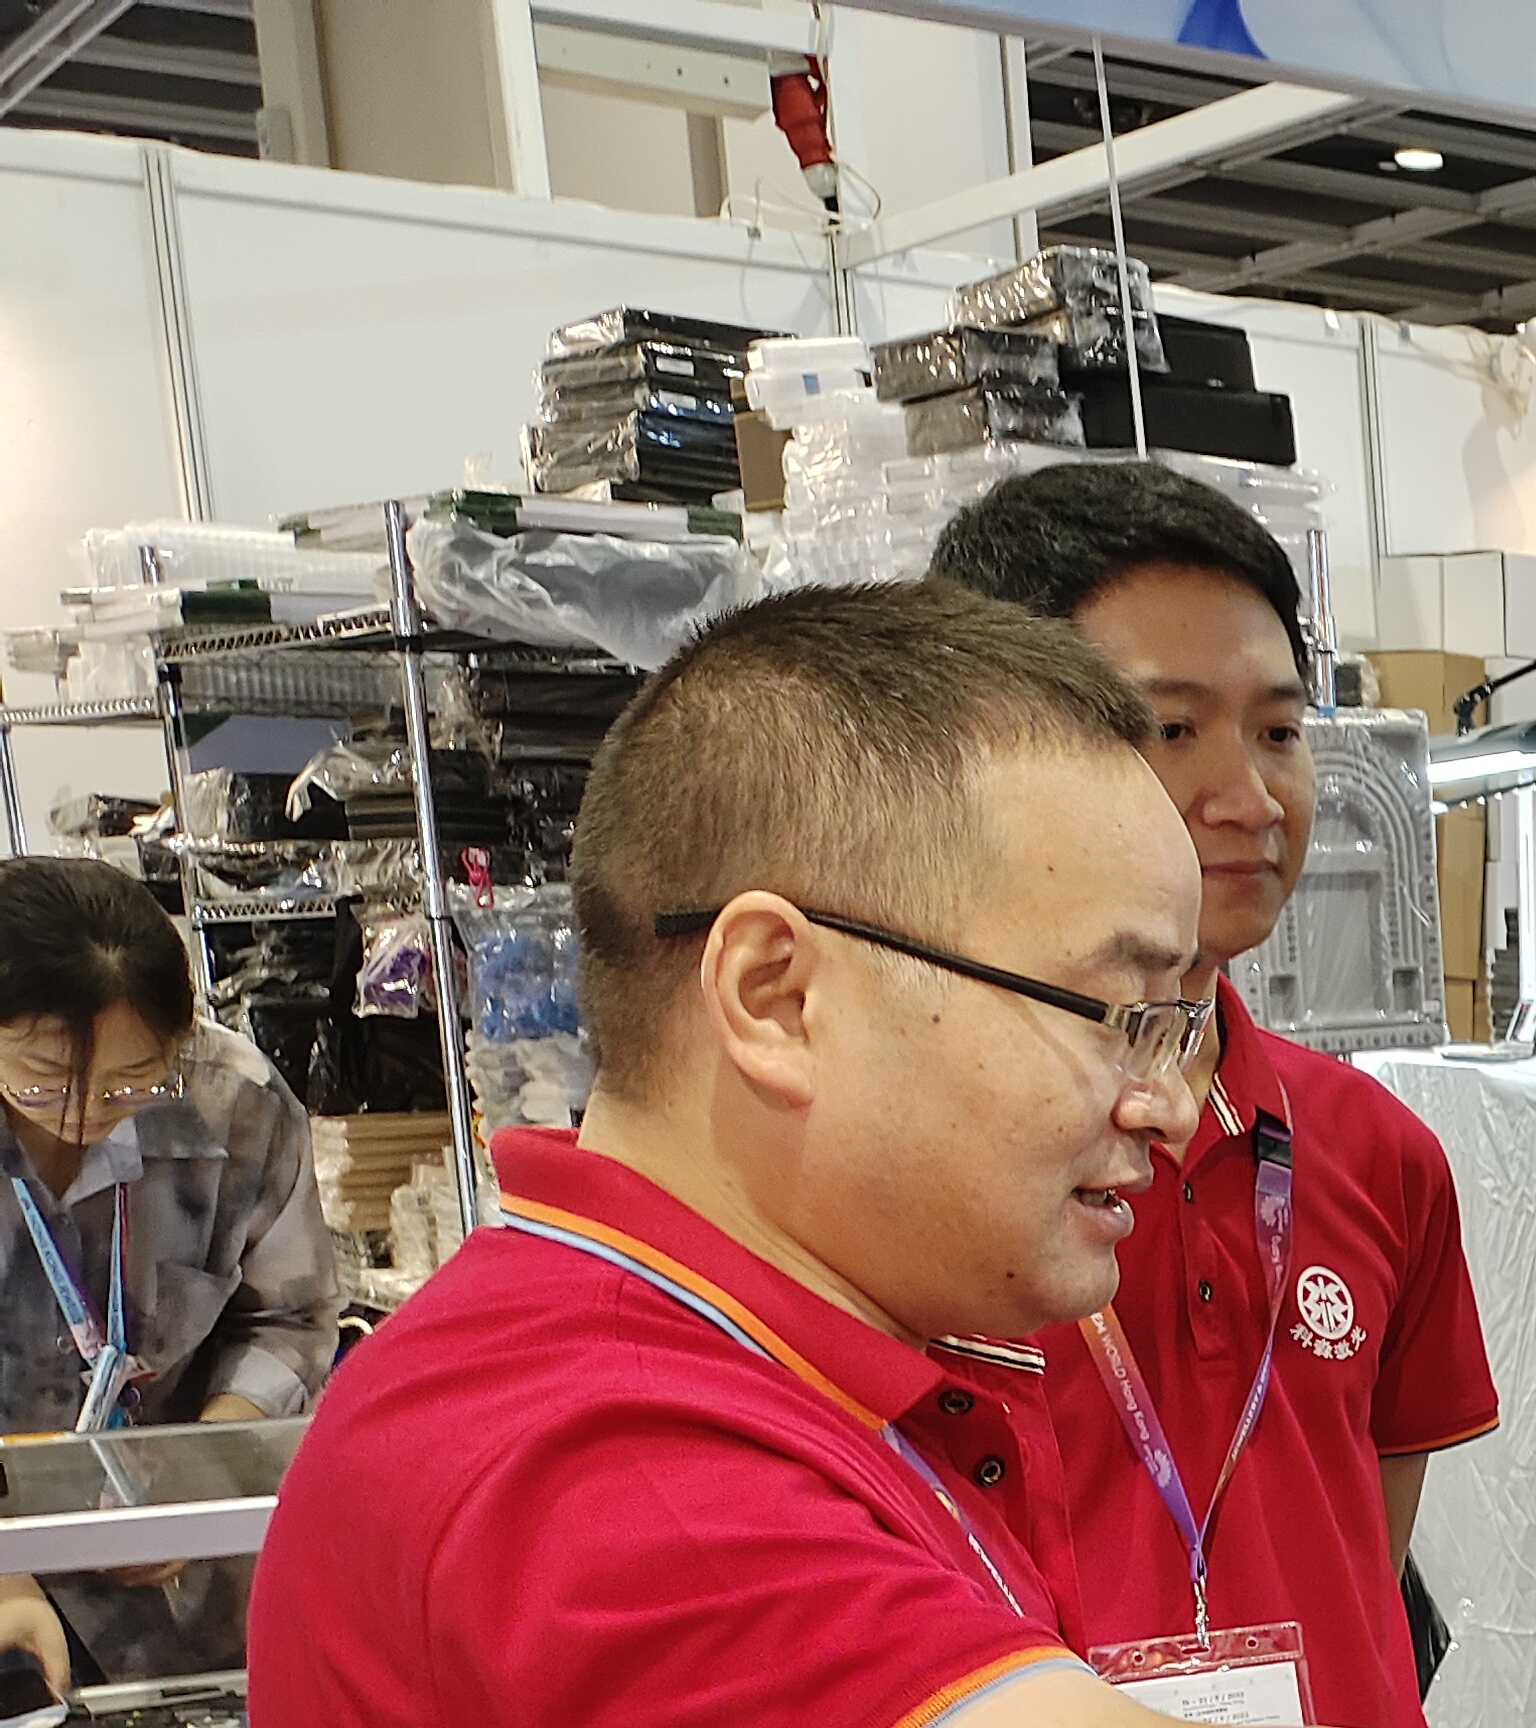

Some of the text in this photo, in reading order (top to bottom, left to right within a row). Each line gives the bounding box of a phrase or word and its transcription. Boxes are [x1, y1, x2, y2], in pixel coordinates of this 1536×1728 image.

[1100, 1335, 1127, 1379] WORLD
[1118, 1379, 1139, 1412] Hong
[1132, 1411, 1151, 1442] Kong
